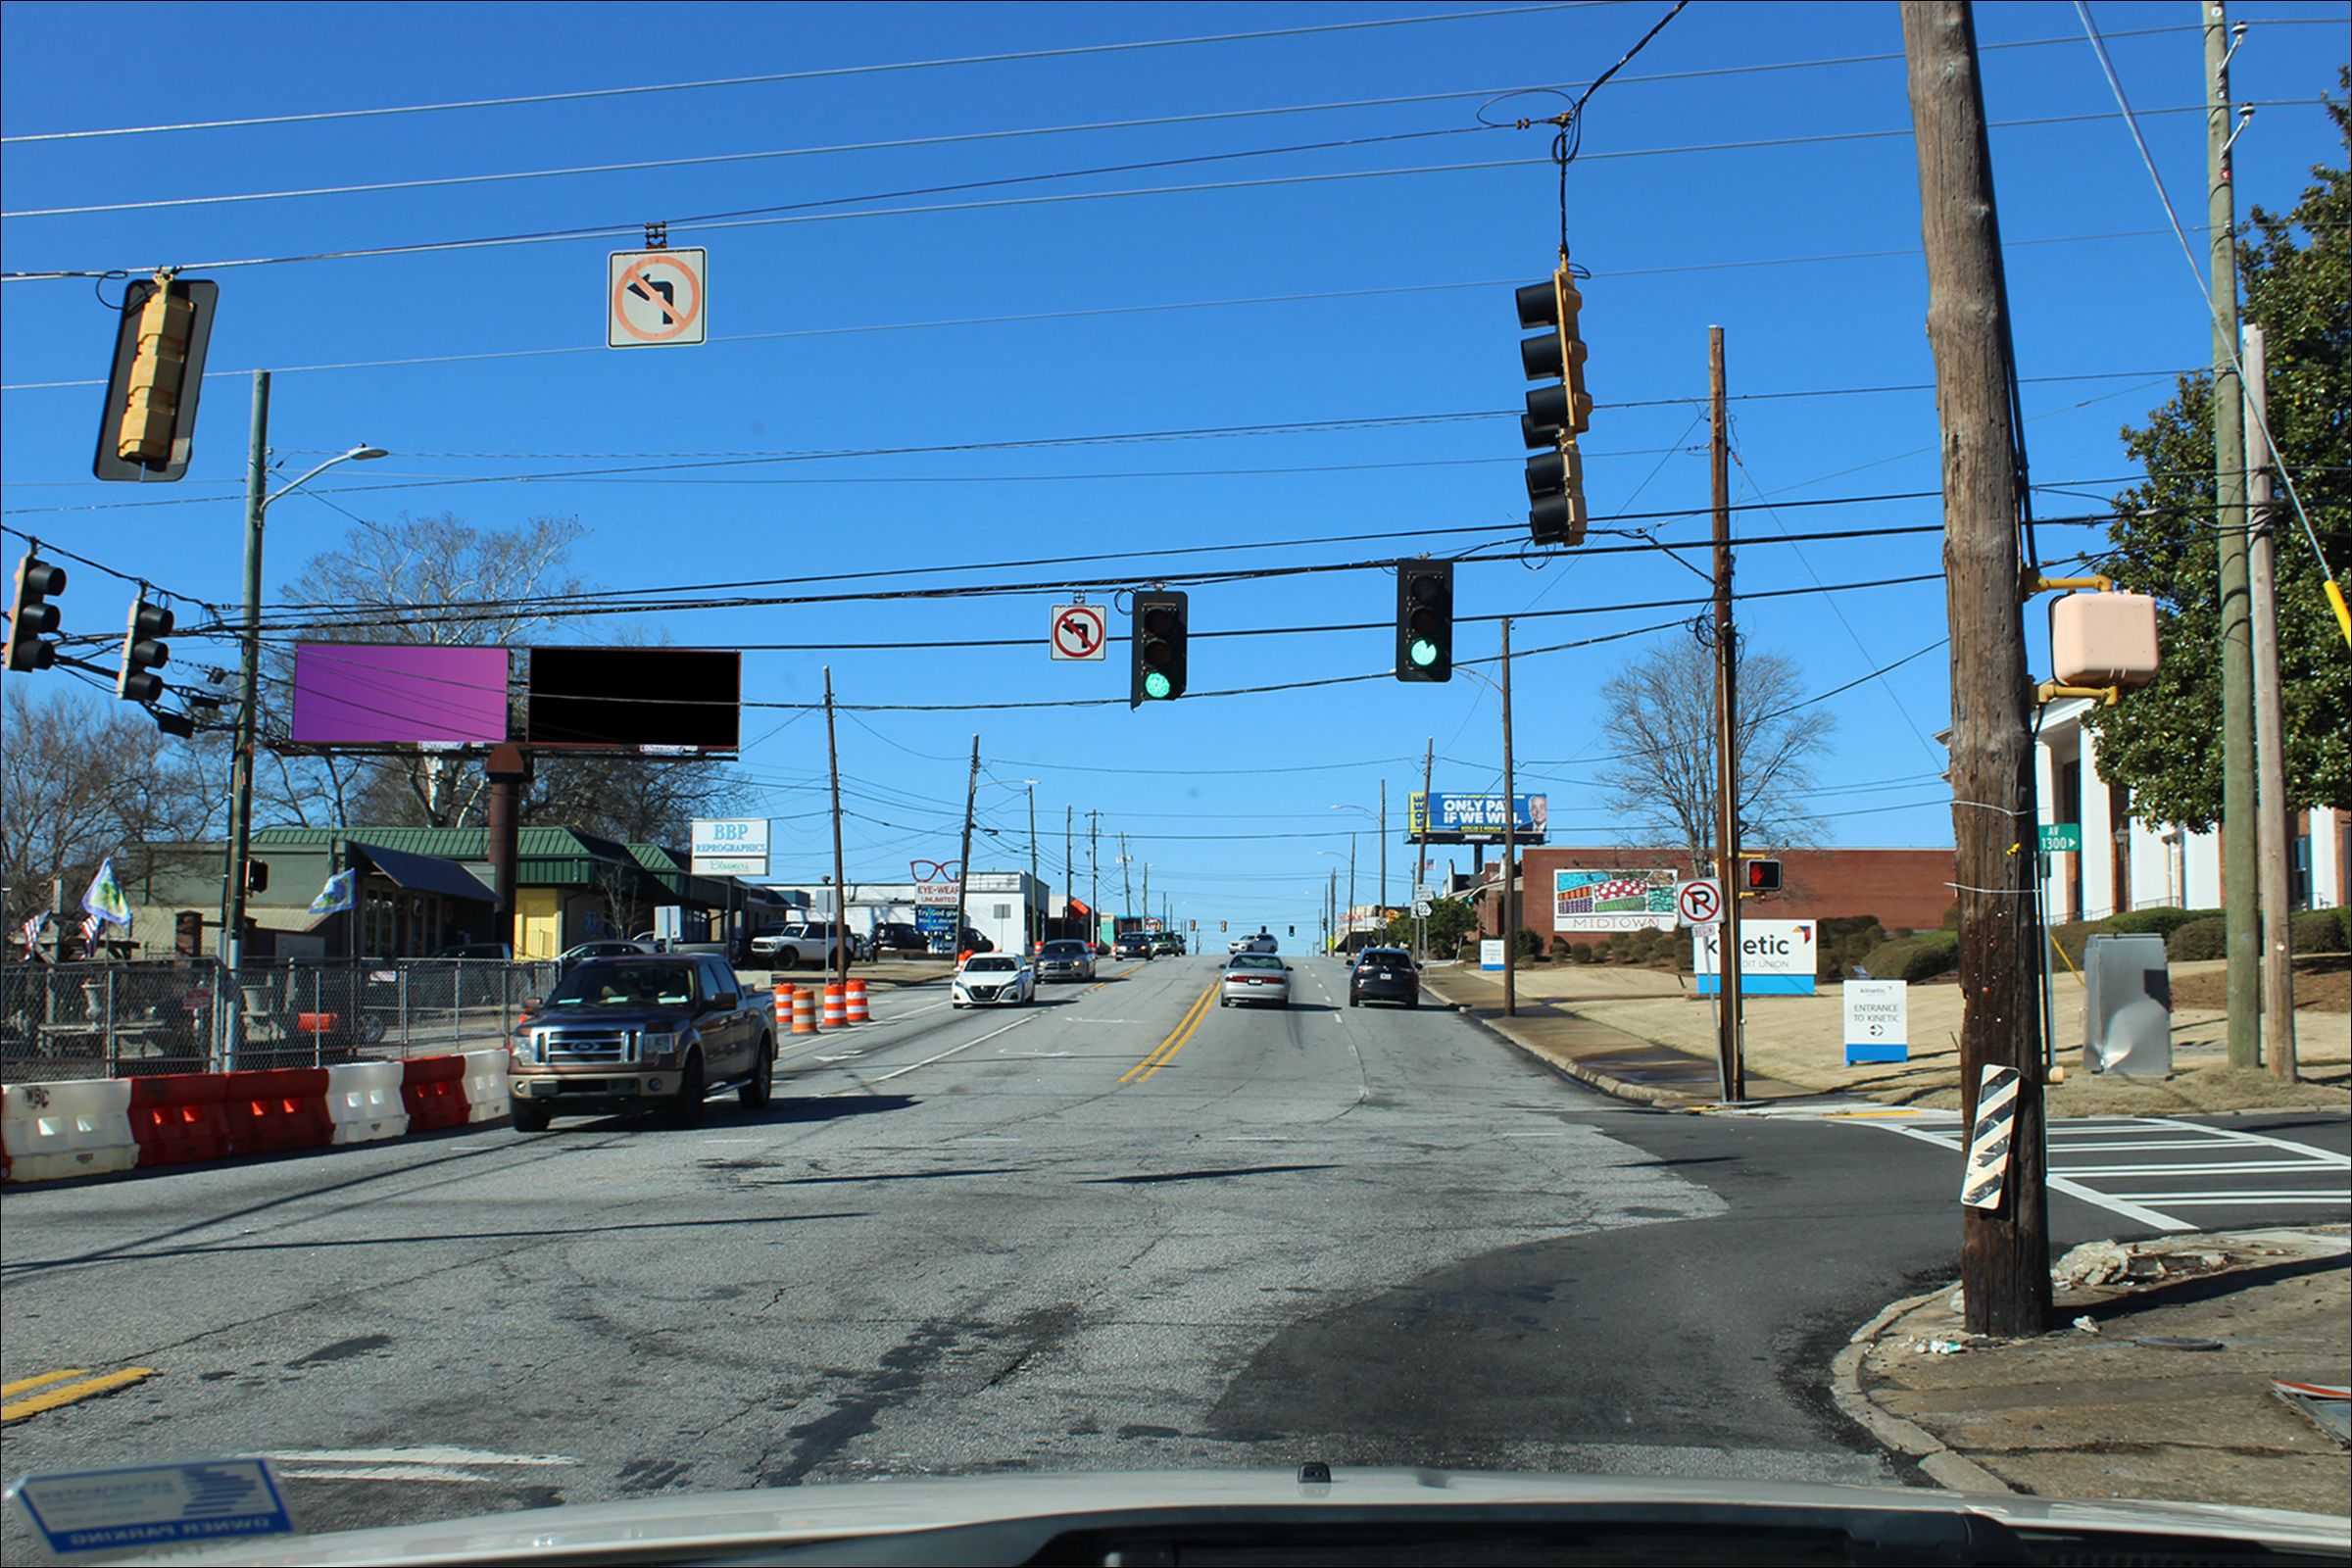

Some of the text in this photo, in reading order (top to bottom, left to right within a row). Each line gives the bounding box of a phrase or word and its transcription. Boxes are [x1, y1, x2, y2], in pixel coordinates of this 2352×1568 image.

[1444, 800, 1507, 812] ONLY PA
[1444, 812, 1456, 823] IF
[1459, 812, 1484, 823] WE
[712, 823, 749, 840] BBP
[2048, 825, 2060, 836] AV
[695, 843, 766, 853] REPROGRAPHICS
[2041, 837, 2067, 850] 1300
[1419, 905, 1429, 913] 22
[1573, 917, 1660, 929] MIDTOWN
